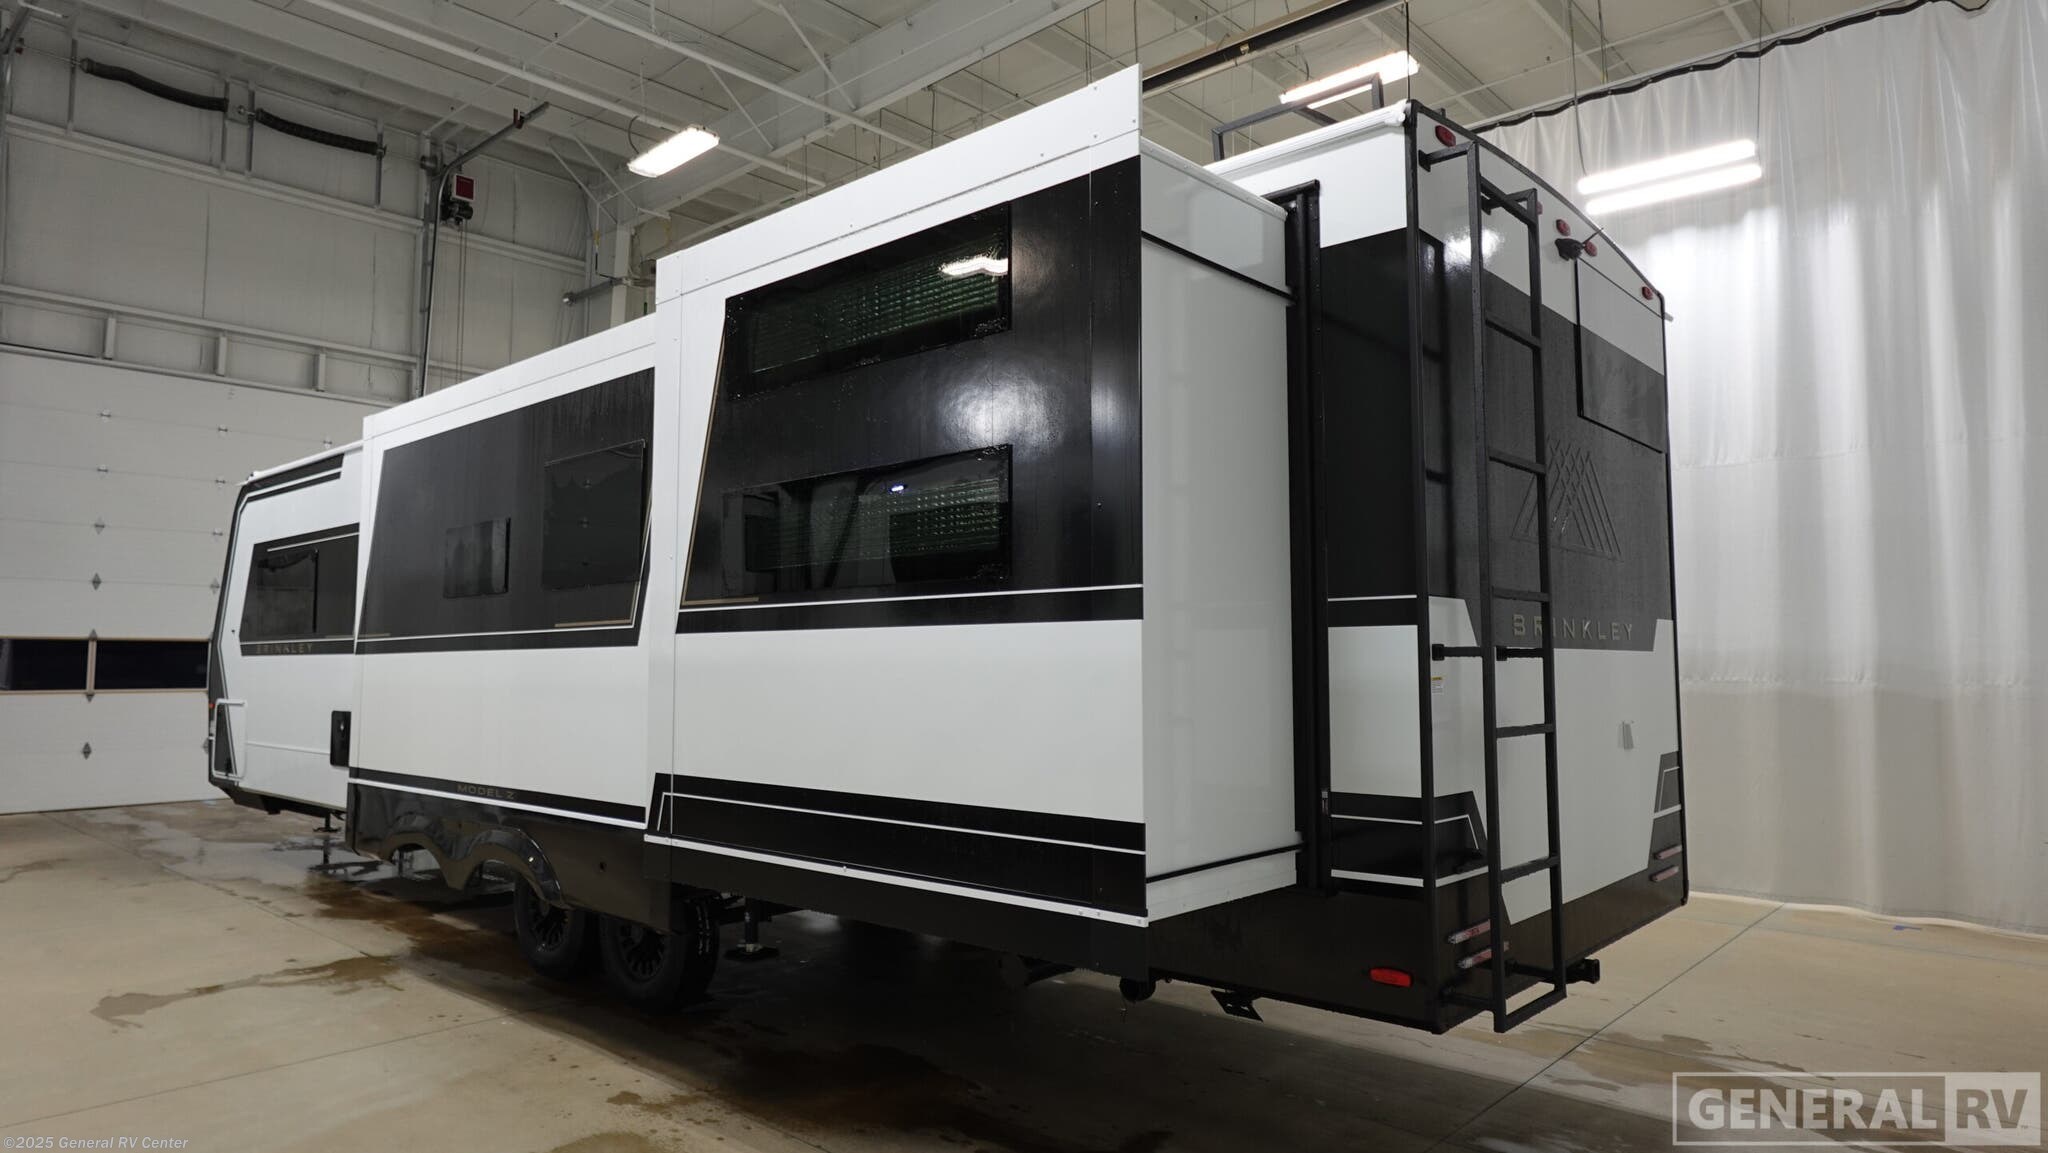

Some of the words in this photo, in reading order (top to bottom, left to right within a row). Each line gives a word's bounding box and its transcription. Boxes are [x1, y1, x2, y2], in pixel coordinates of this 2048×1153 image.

[1513, 613, 1632, 641] BRINKLEY
[456, 783, 503, 798] MODEL
[507, 790, 517, 800] Z
